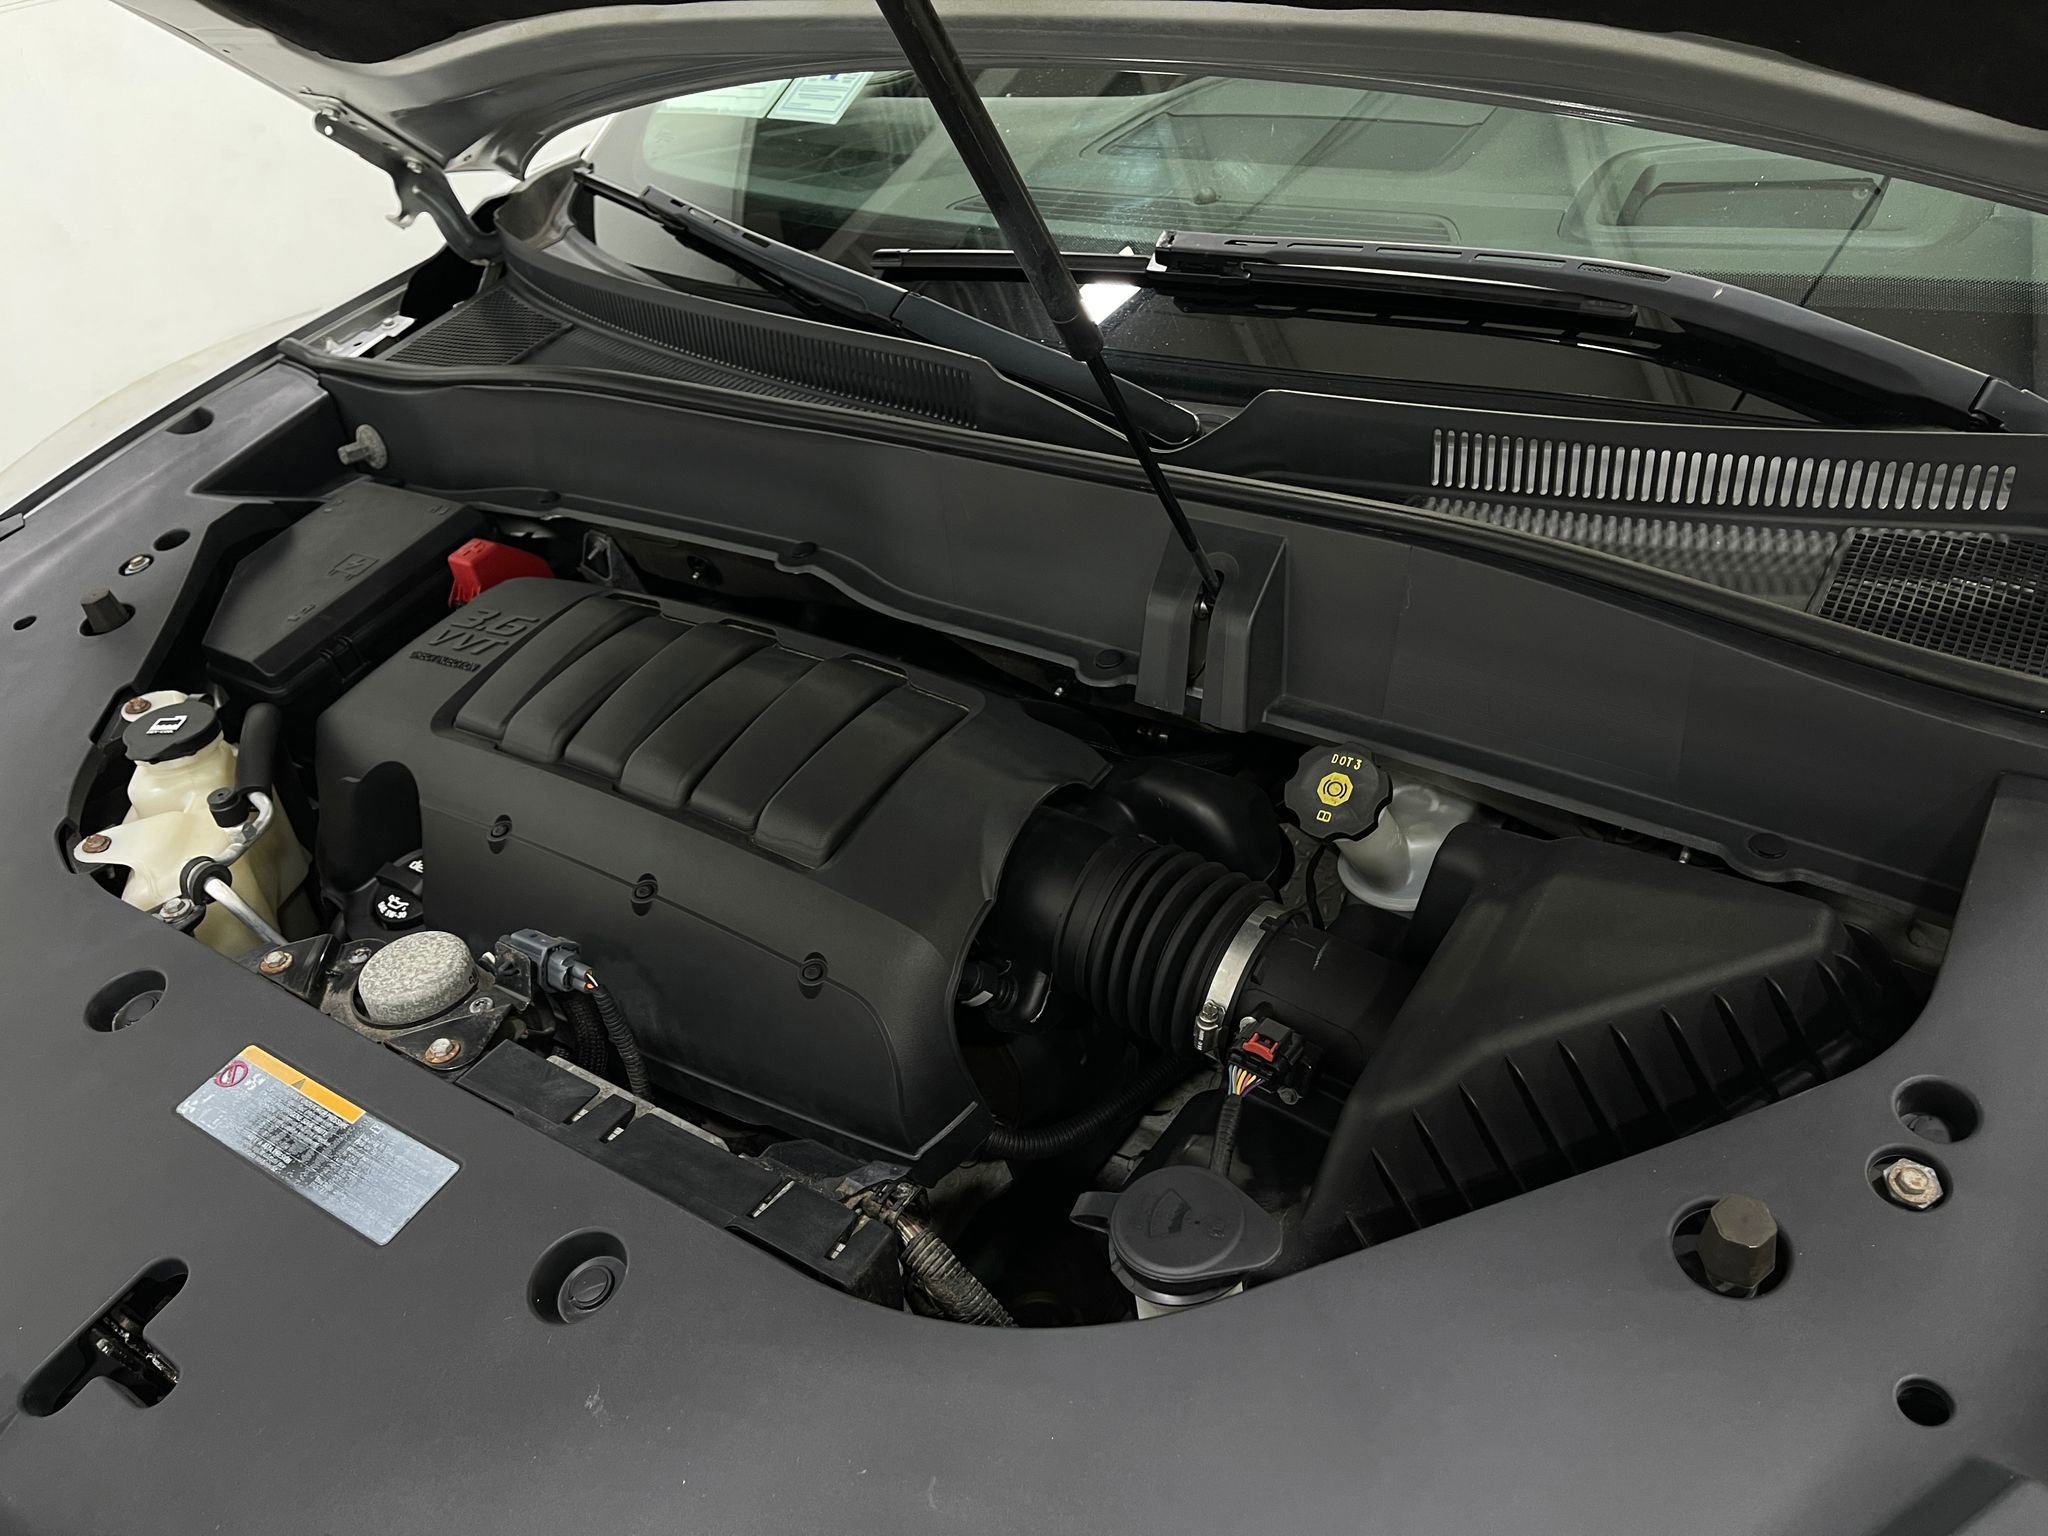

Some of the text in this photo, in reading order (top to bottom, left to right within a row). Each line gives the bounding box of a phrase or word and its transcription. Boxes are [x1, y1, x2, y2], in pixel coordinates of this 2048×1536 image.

[450, 610, 540, 637] 3.6
[428, 630, 510, 655] VVT
[1331, 753, 1363, 770] DOT 3
